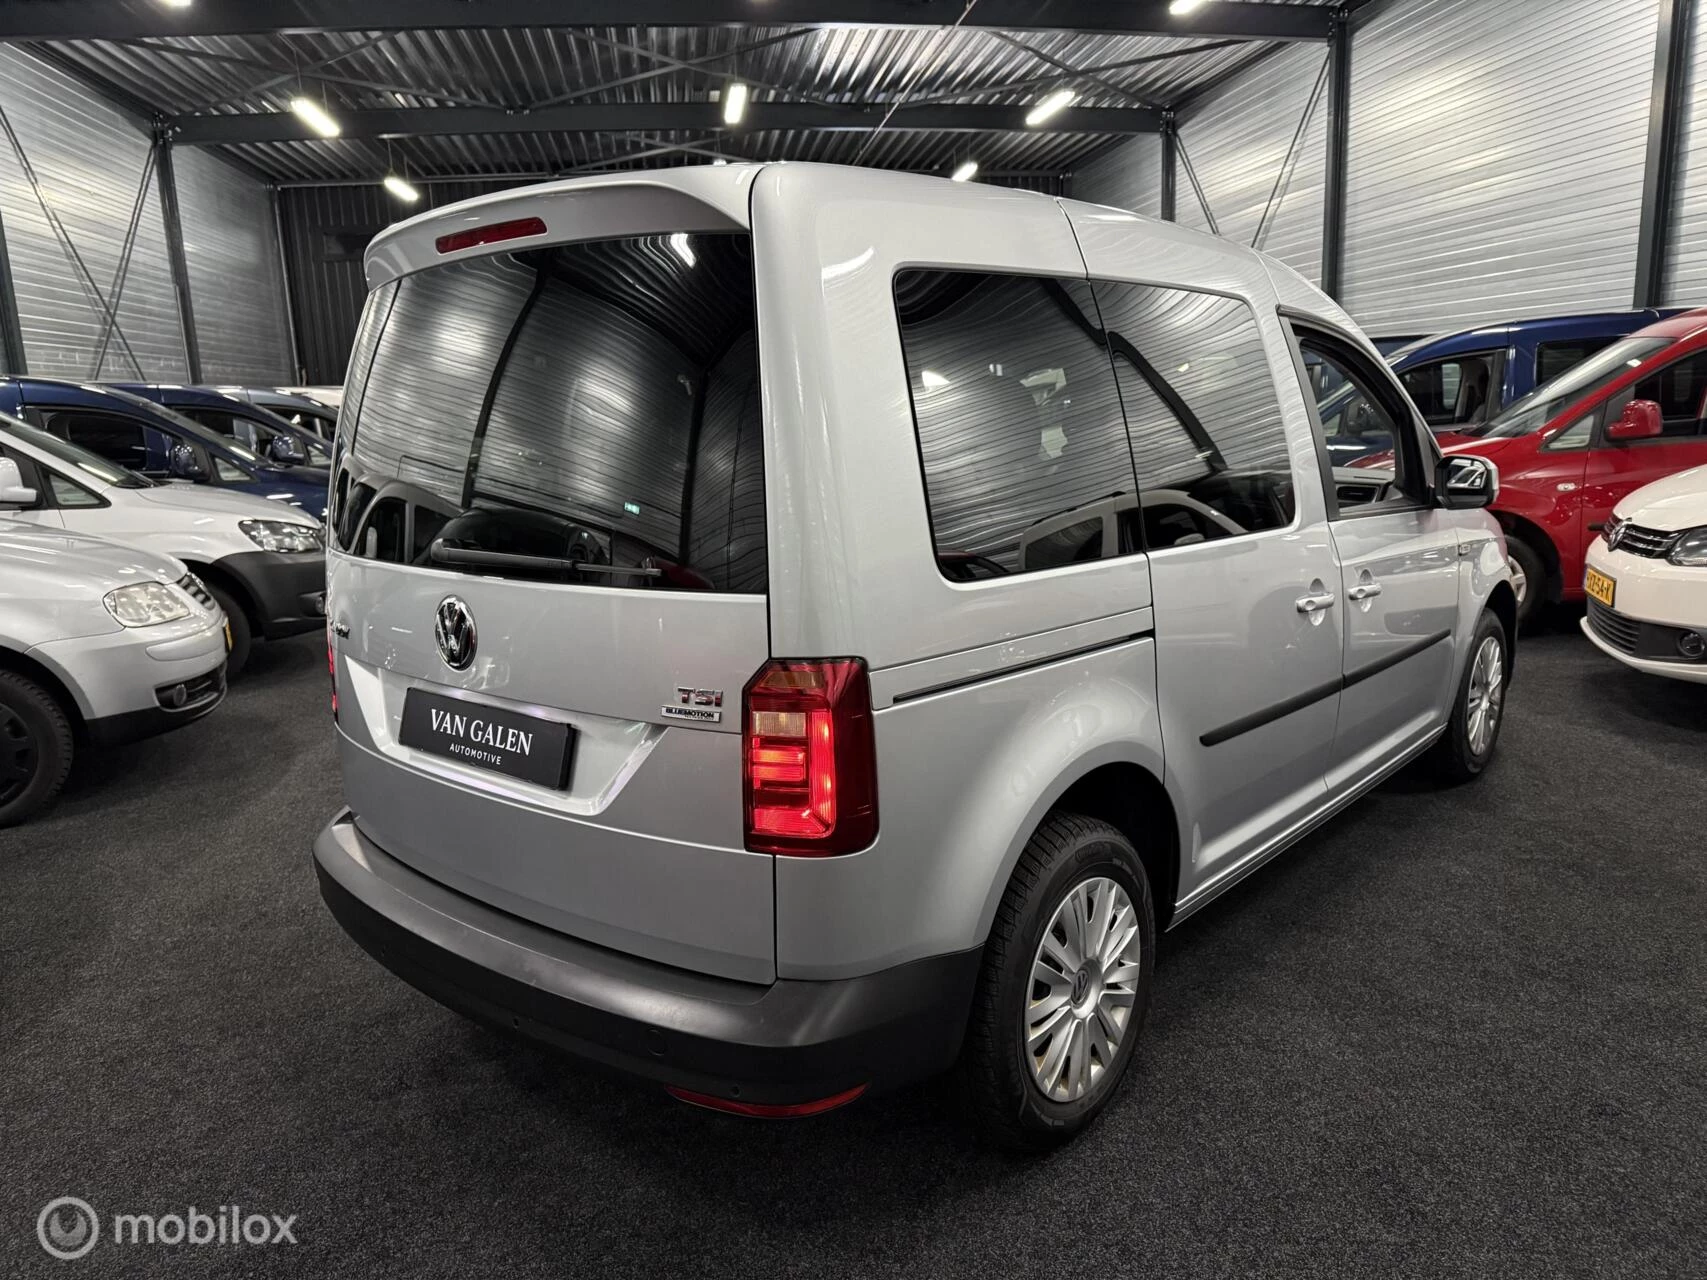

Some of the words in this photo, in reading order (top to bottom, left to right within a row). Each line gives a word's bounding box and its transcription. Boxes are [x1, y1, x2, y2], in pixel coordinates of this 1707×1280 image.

[677, 686, 723, 707] TSI
[665, 706, 715, 718] BLUEMOTION
[430, 708, 468, 738] VAN
[470, 719, 534, 756] GALEN
[449, 742, 502, 766] AUTOMOTIVE
